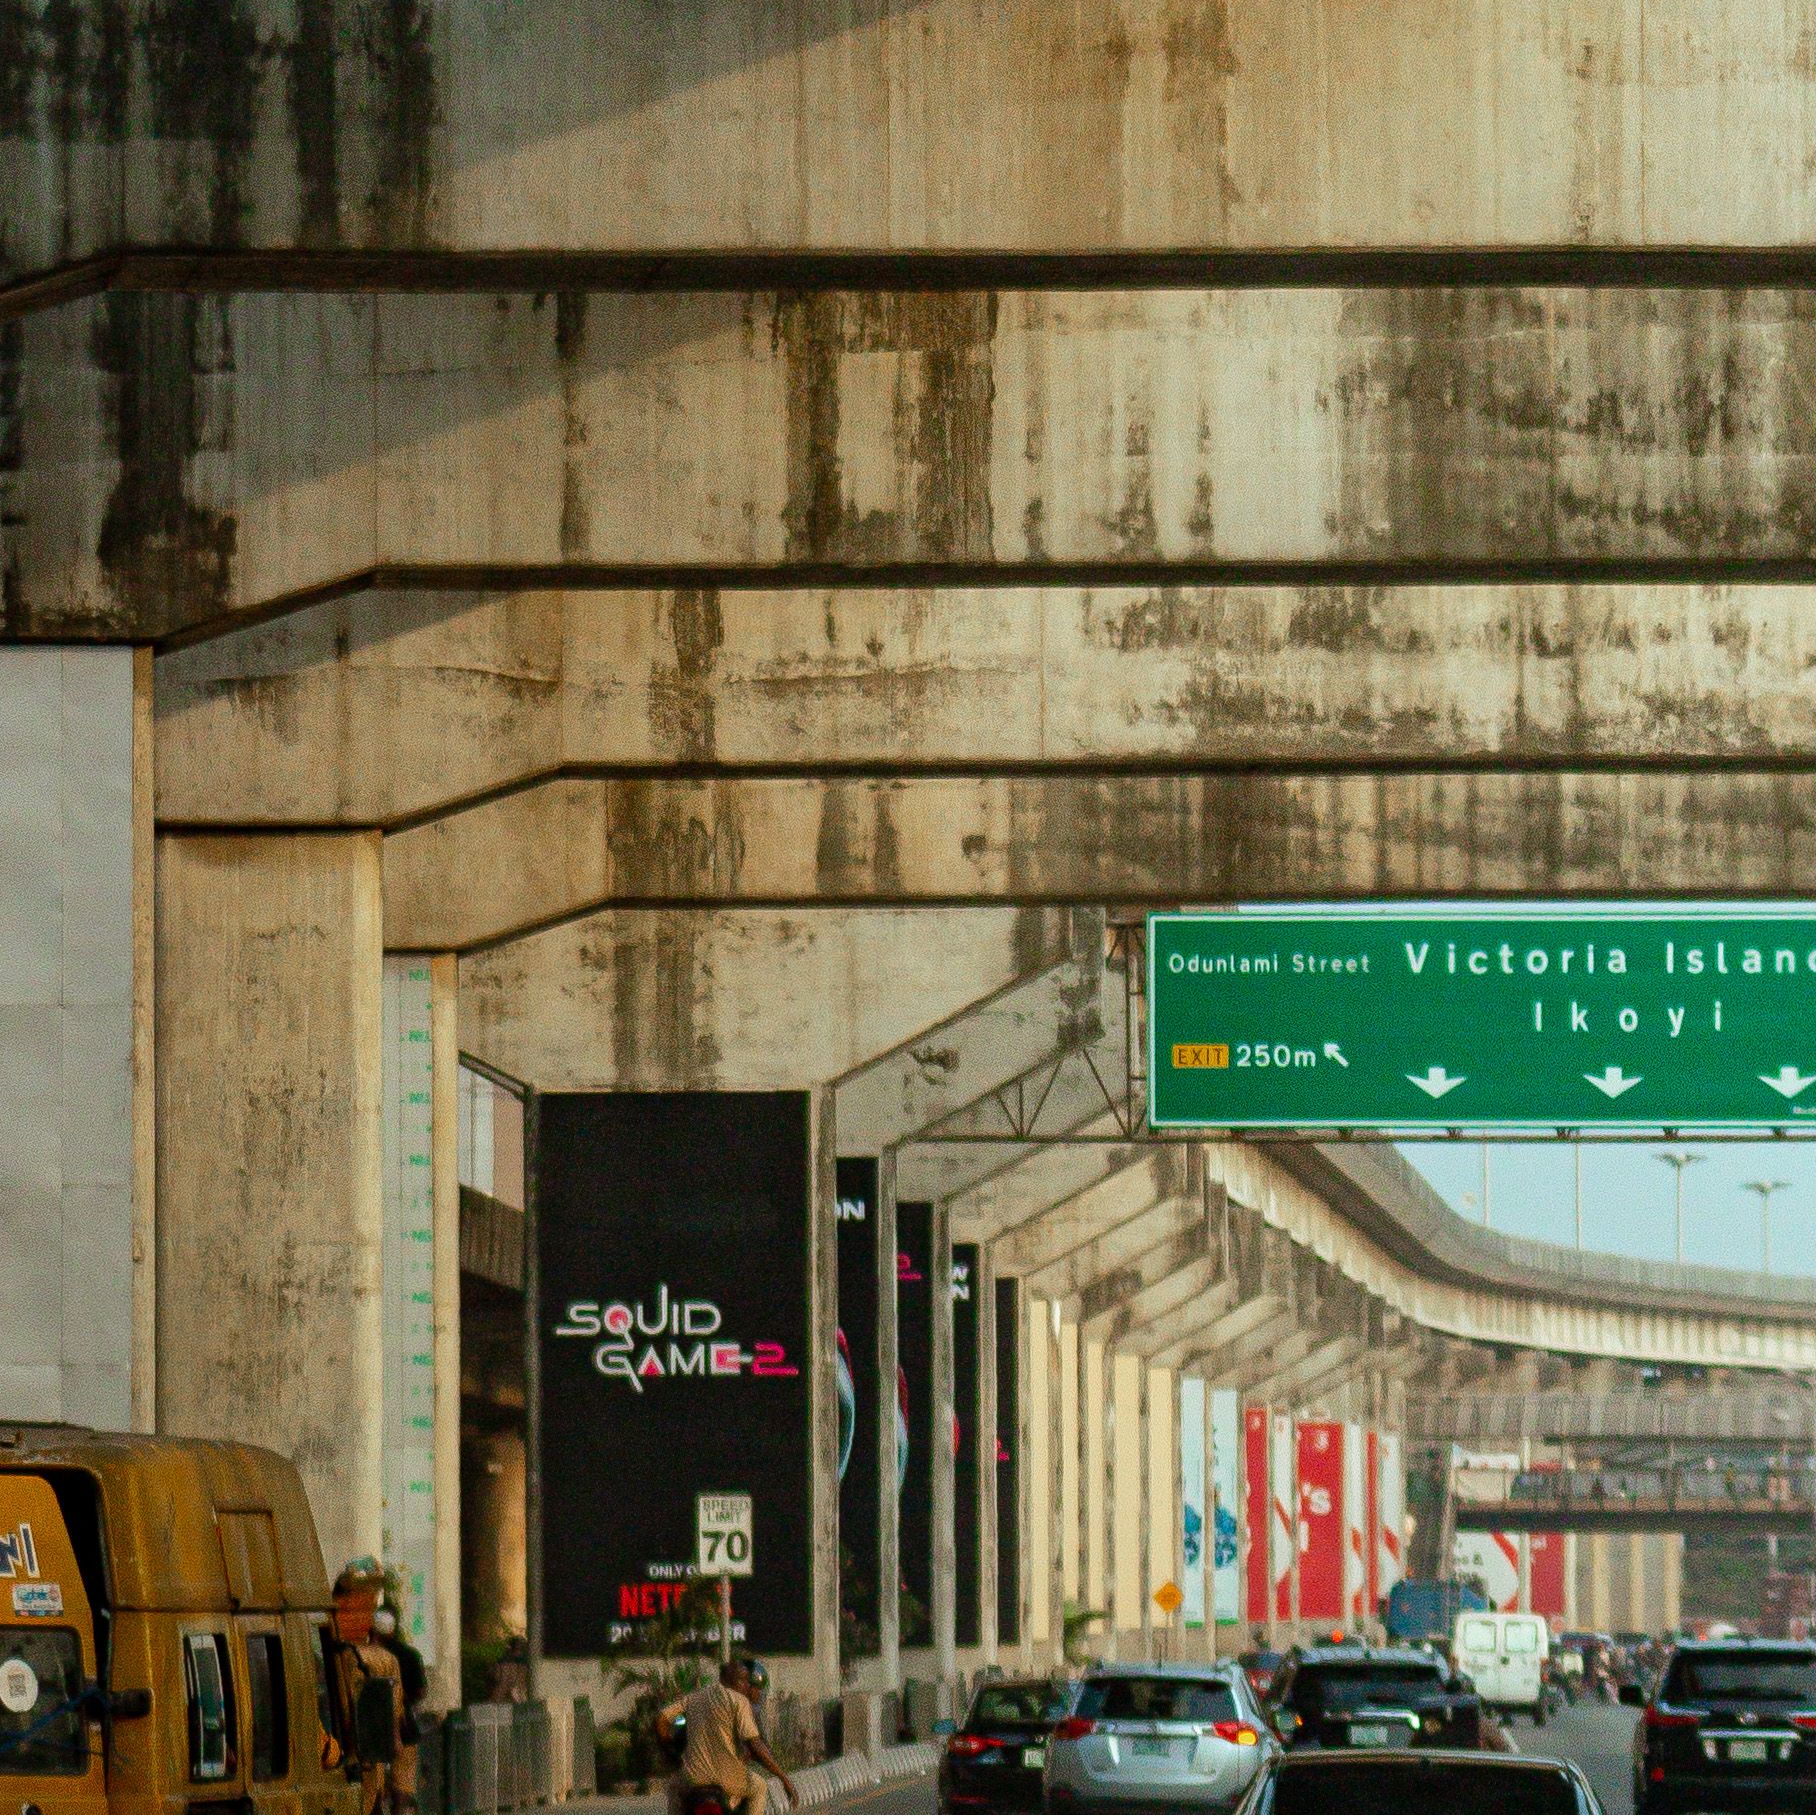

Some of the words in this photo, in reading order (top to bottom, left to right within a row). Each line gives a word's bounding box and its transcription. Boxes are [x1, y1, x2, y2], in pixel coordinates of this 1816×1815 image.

[1168, 952, 1279, 975] Odunlami
[1292, 952, 1371, 975] Street
[1404, 941, 1628, 975] Victoria
[1534, 1000, 1724, 1038] Ikoyi
[1177, 1047, 1225, 1066] EXIT
[1236, 1043, 1317, 1068] 250m
[555, 1283, 722, 1337] SQUID
[702, 1498, 750, 1513] SPEED
[706, 1512, 742, 1524] LIMIT
[702, 1529, 749, 1563] 70
[649, 1563, 684, 1578] ONLY
